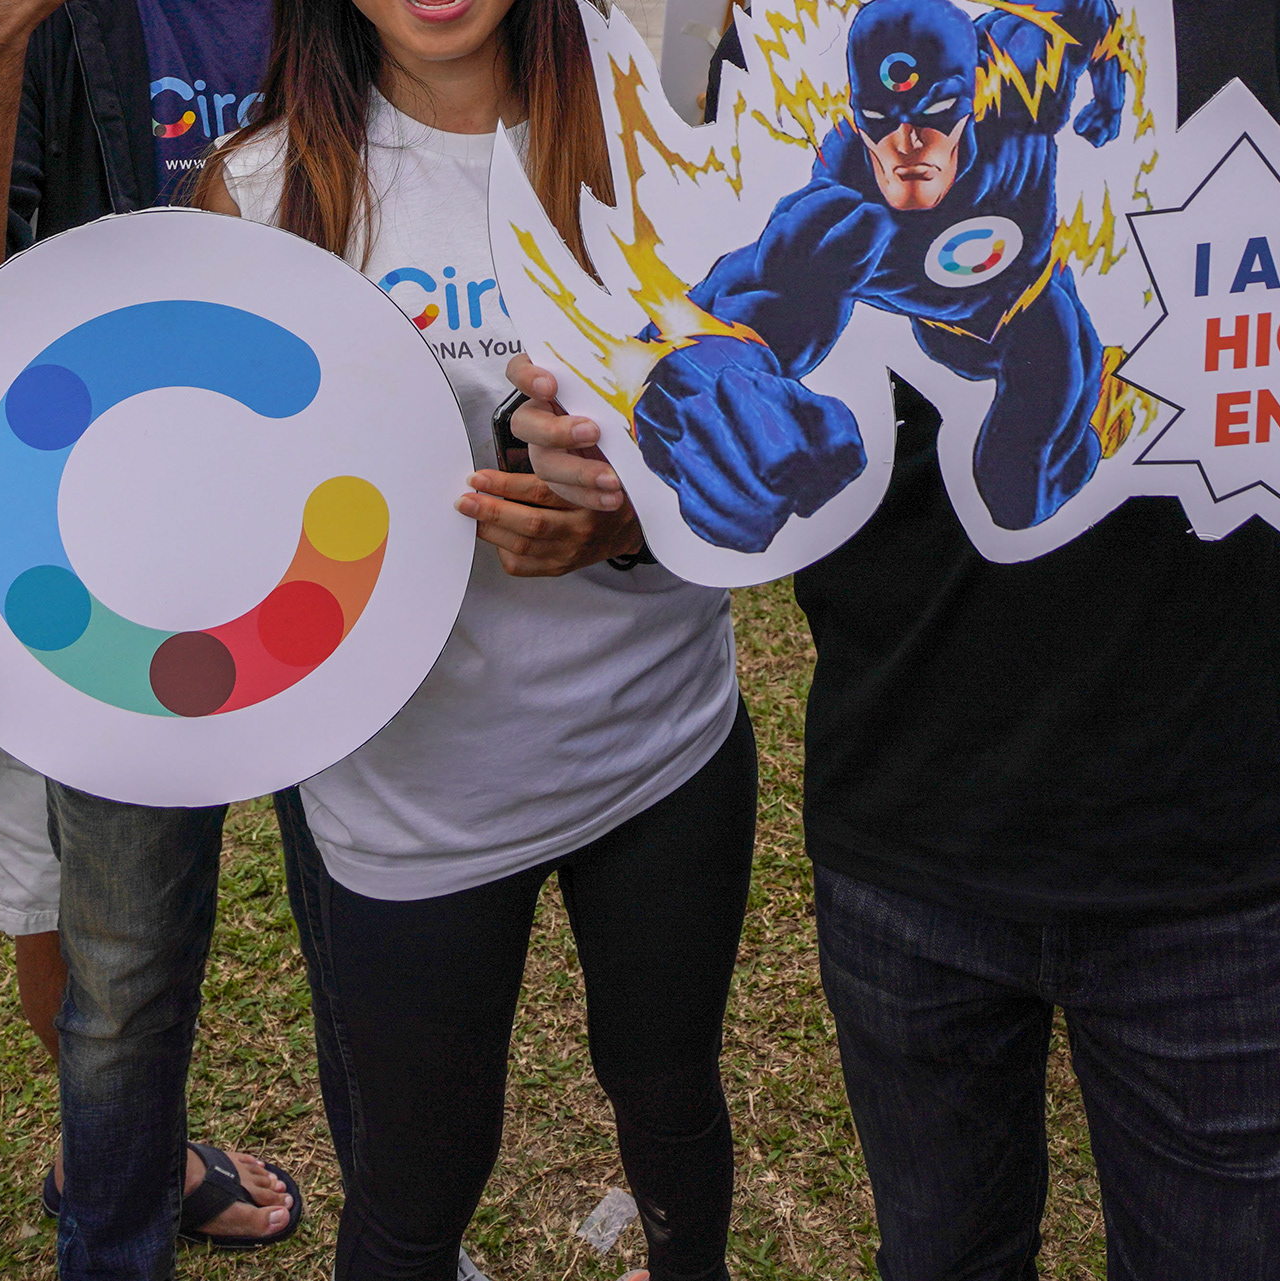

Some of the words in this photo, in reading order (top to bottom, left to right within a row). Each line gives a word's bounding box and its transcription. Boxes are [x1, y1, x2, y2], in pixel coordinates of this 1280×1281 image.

[149, 76, 266, 138] Circ
[1194, 242, 1211, 297] I
[432, 341, 474, 360] NA
[478, 338, 524, 358] You
